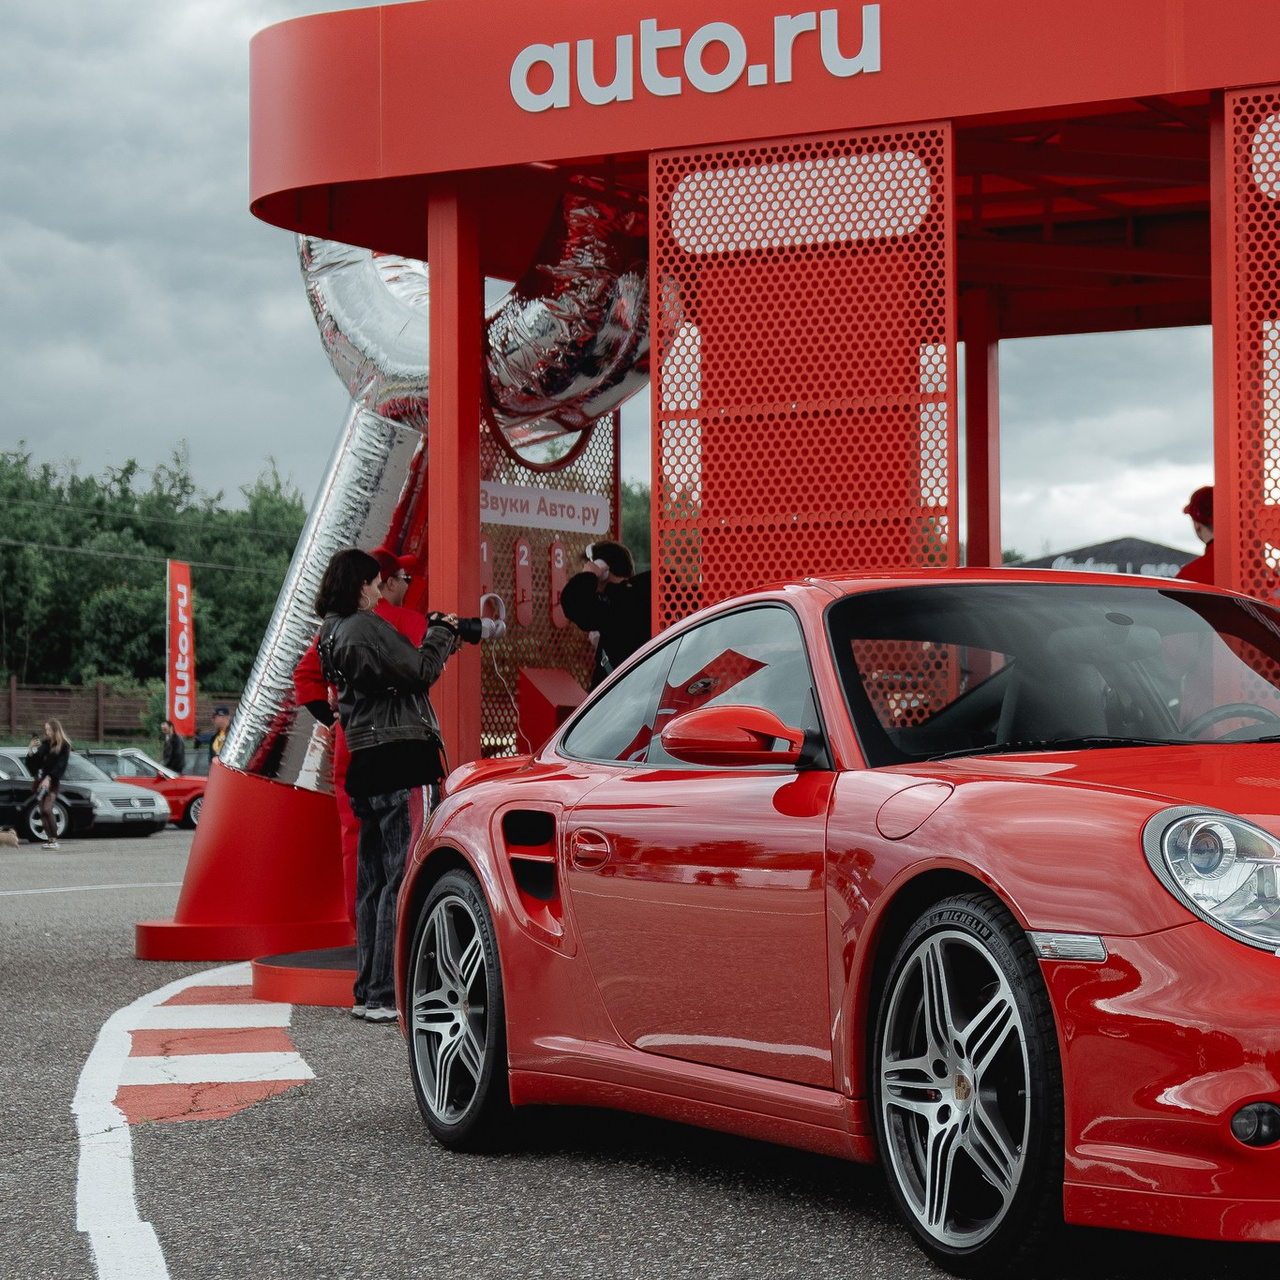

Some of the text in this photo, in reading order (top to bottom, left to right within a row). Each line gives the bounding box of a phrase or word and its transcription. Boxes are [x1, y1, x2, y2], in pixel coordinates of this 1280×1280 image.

[509, 3, 882, 113] auto.ru
[480, 489, 600, 526] Звуки Авто.ру
[480, 542, 487, 562] 1
[519, 545, 529, 566] 2
[554, 548, 564, 568] 3
[174, 583, 189, 720] auto.ru
[473, 900, 493, 965] MICHELIN
[941, 911, 990, 938] MICHELIN
